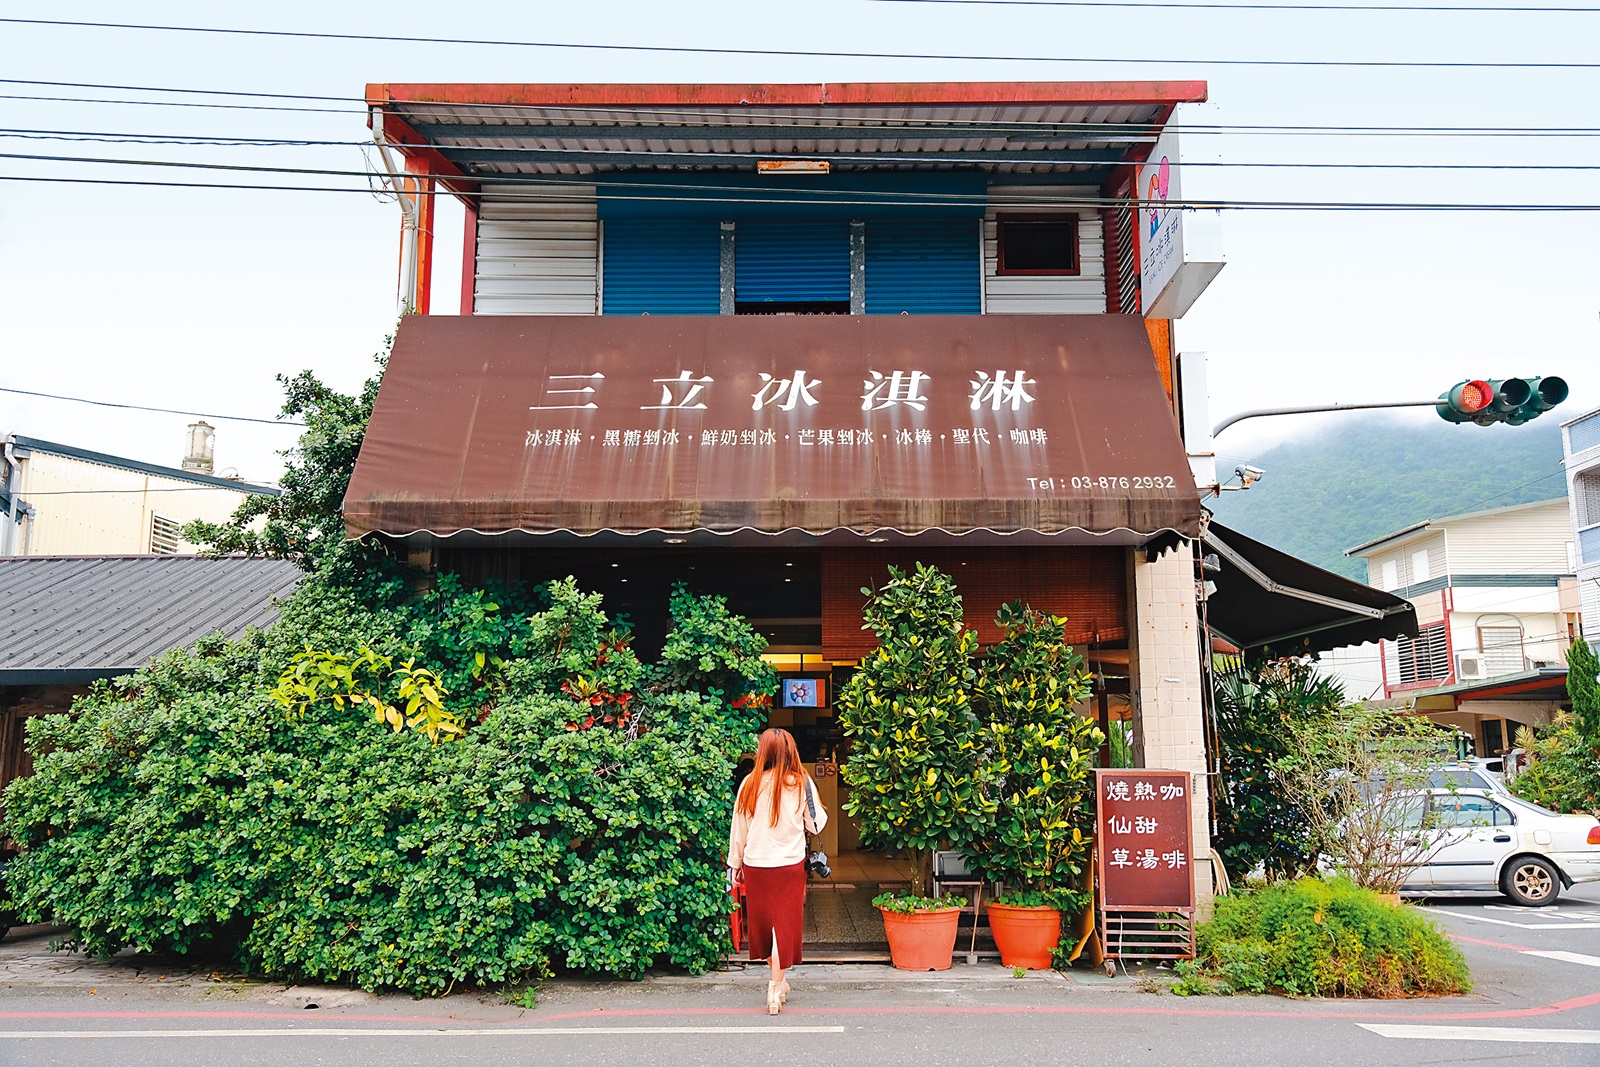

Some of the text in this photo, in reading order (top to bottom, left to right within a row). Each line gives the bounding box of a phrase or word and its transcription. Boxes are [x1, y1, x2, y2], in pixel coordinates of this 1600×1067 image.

[528, 370, 1037, 411] 三立冰淇淋
